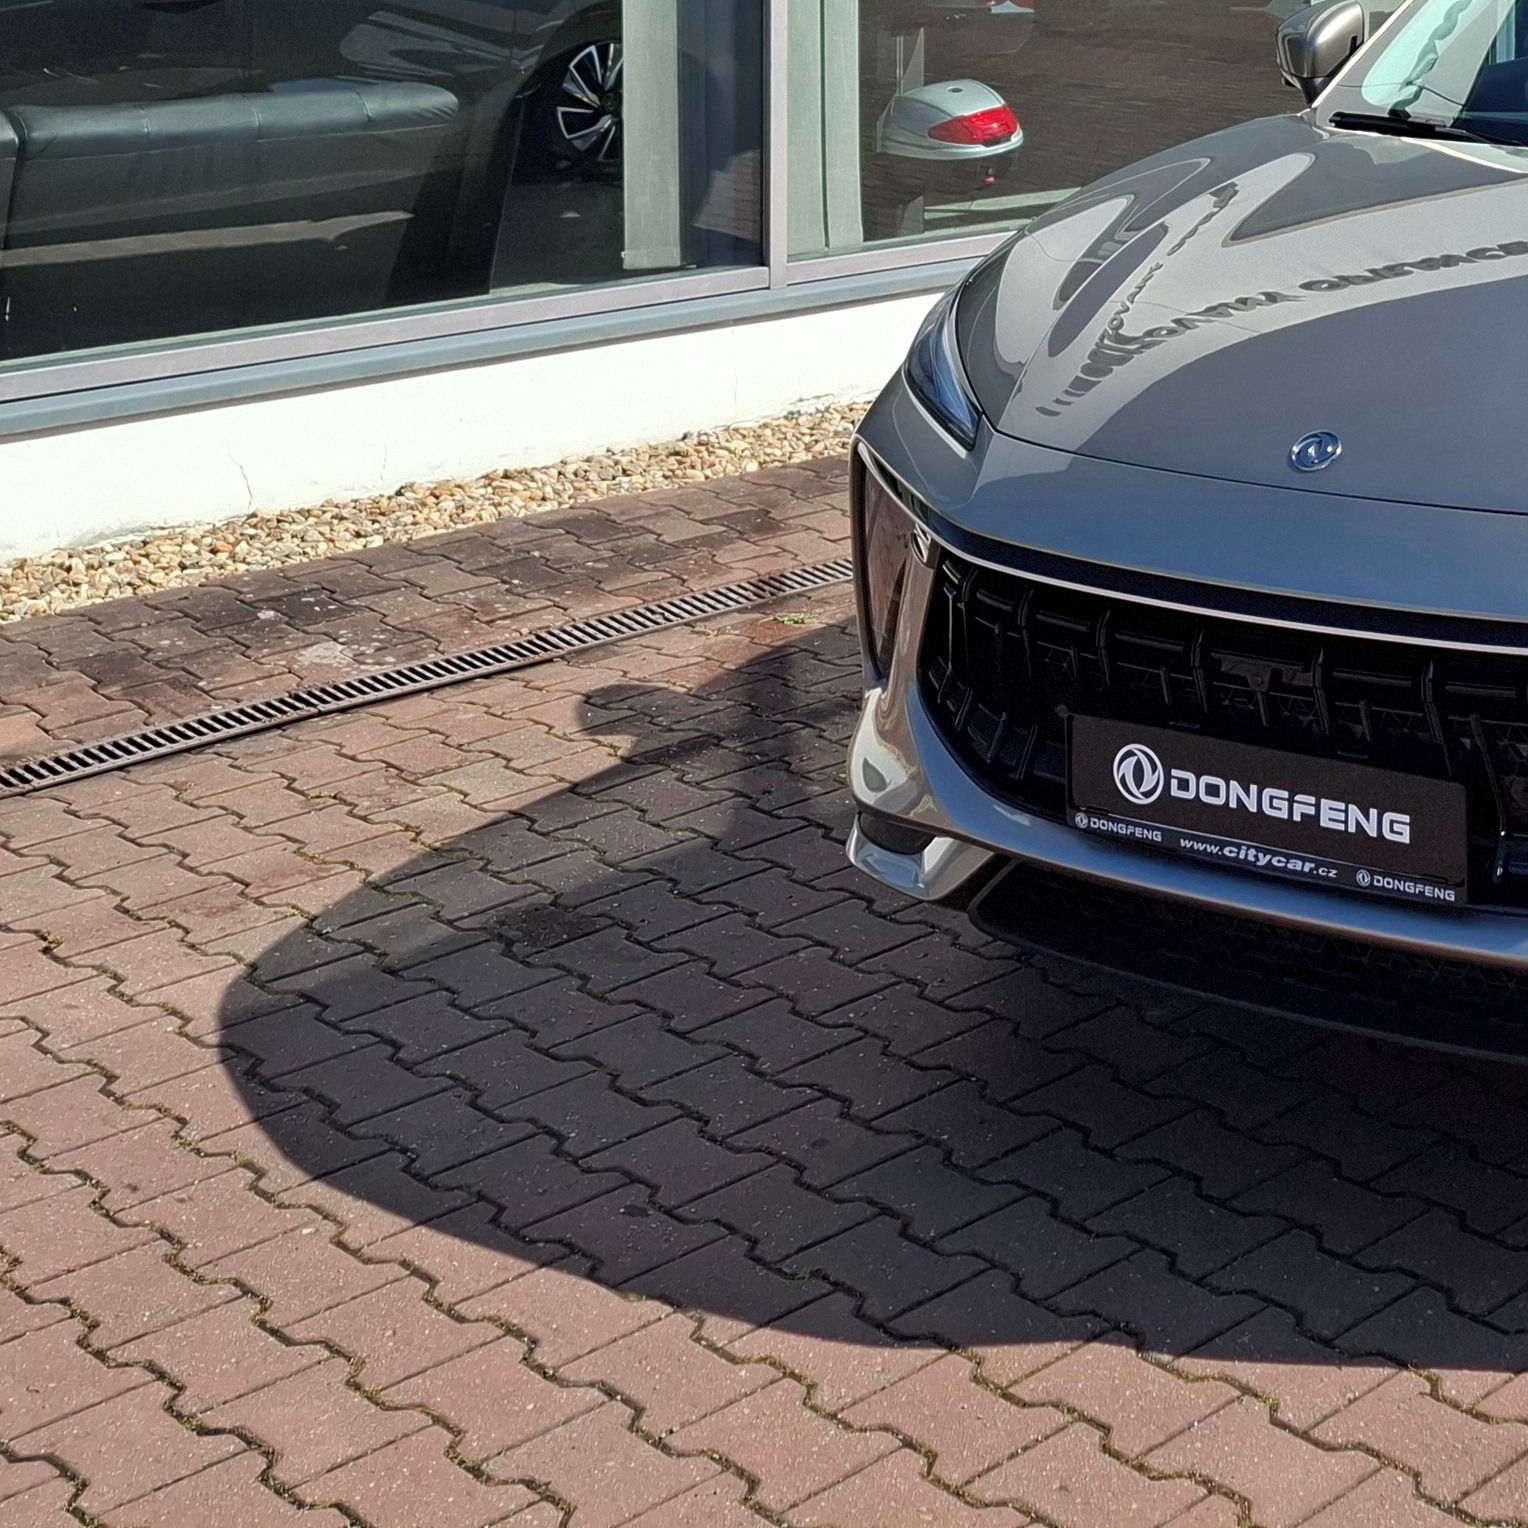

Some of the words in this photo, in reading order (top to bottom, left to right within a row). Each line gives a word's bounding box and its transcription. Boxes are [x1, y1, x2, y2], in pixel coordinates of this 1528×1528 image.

[1170, 768, 1411, 845] DONGFENG
[1089, 817, 1163, 842] DONGFENG
[1179, 836, 1339, 878] www.citycar.cz
[1373, 875, 1456, 902] DONGFENG
